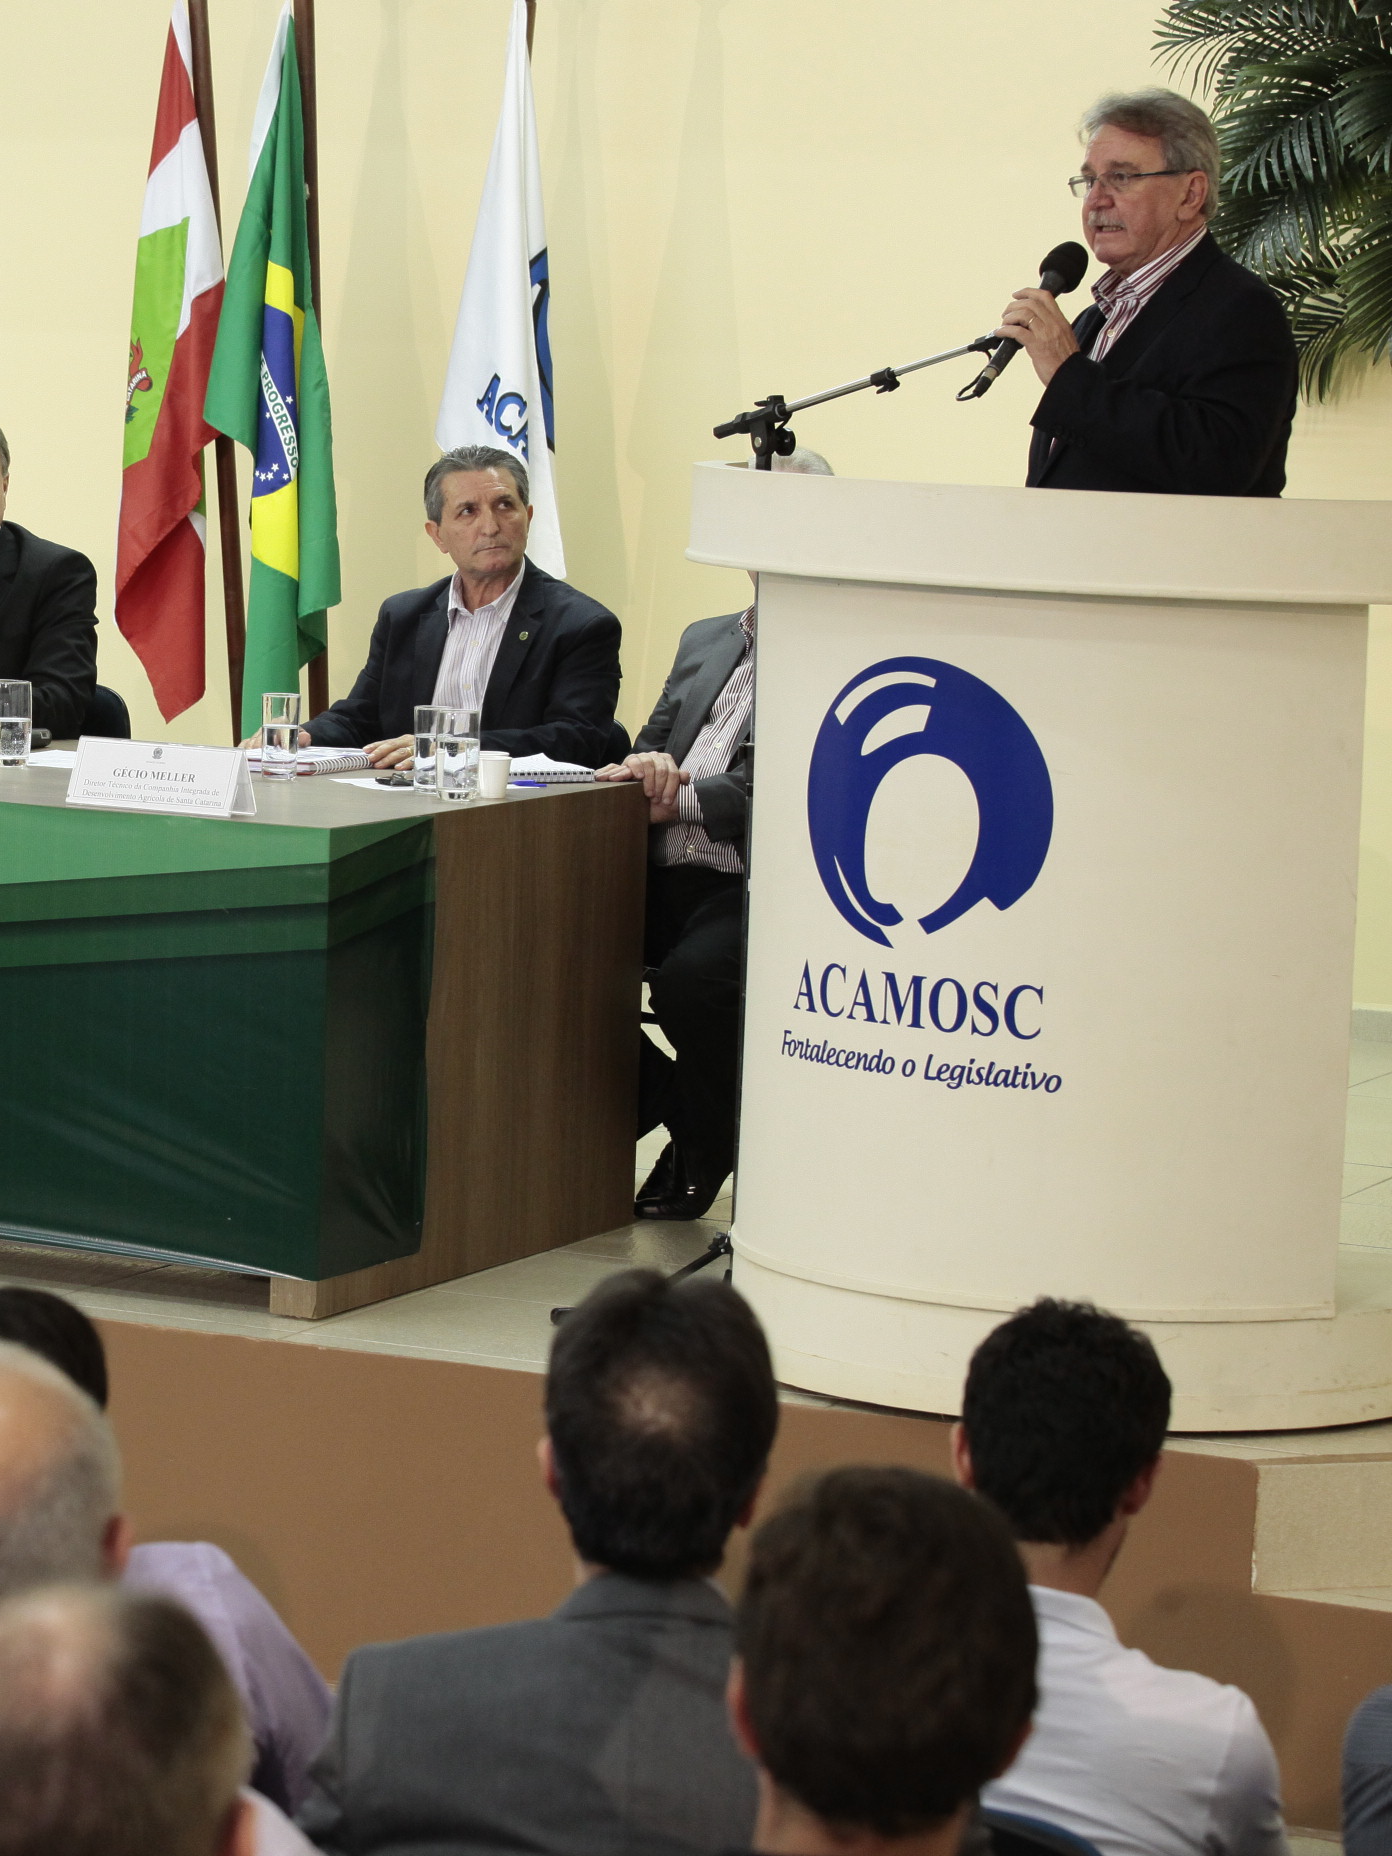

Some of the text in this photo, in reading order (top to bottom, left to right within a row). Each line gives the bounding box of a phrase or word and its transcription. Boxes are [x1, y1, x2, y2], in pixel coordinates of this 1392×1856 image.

[262, 371, 299, 469] PROGRESSO
[83, 779, 106, 787] Diretor
[108, 780, 133, 789] Técnico
[143, 783, 179, 793] Companhia
[181, 786, 210, 795] Integrada
[113, 766, 195, 783] GÉCIO MELLER
[82, 789, 136, 800] Desenvolvimento
[137, 793, 165, 803] Agrícola
[175, 797, 193, 805] Santa
[194, 798, 222, 807] Catarina
[793, 958, 1044, 1040] ACAMOSC
[781, 1029, 1062, 1093] Fortalecendo o Legislativo
